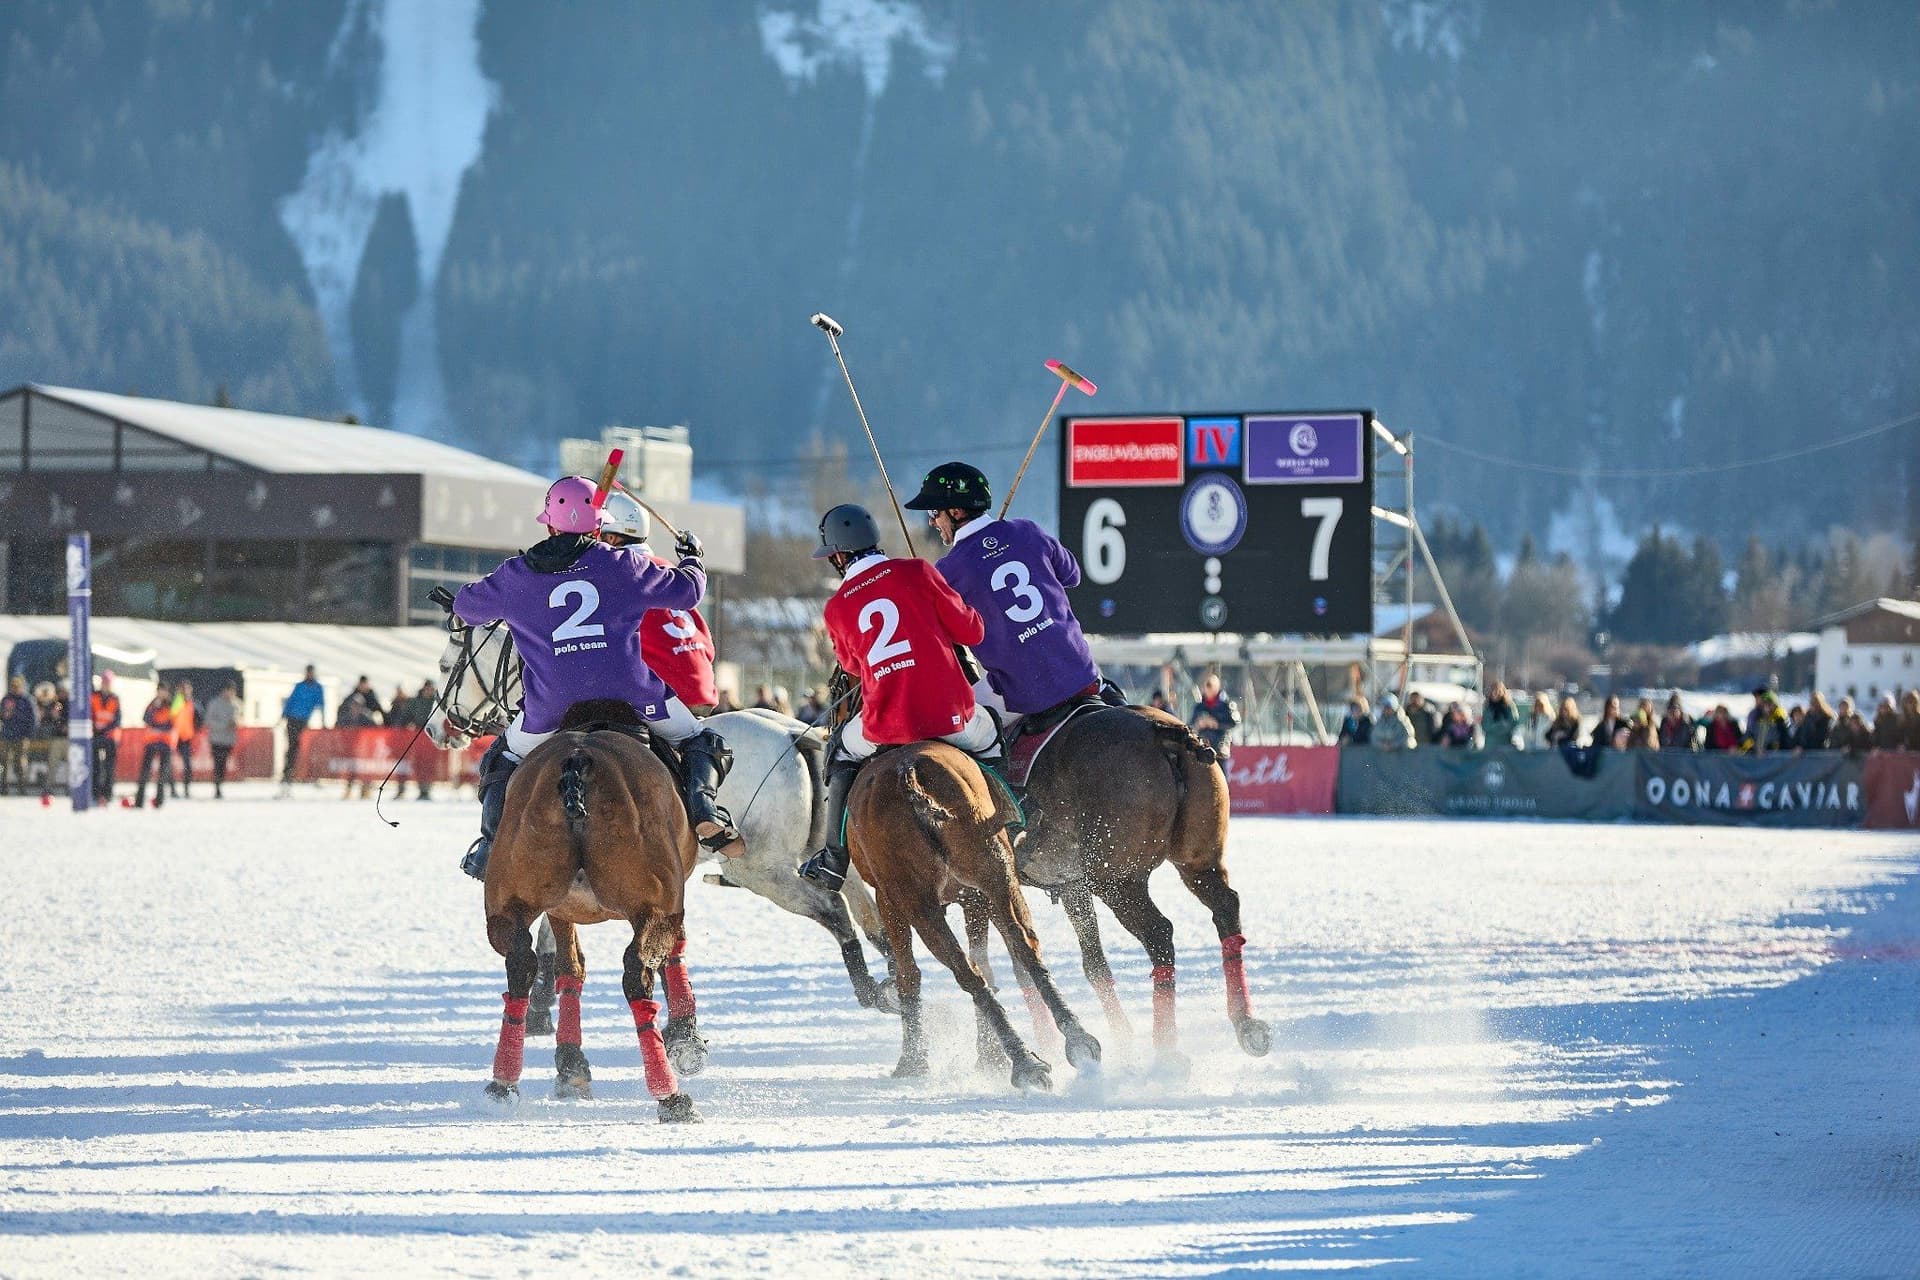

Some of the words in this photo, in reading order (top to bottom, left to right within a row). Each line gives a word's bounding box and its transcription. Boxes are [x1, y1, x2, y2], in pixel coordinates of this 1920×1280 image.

[1193, 426, 1235, 464] IV
[1083, 497, 1126, 585] 6
[1301, 496, 1343, 581] 7
[549, 579, 605, 642] 2
[991, 560, 1044, 623] 3
[554, 643, 578, 656] polo
[579, 641, 608, 651] team
[858, 597, 912, 667] 2
[1018, 625, 1038, 643] polo
[1036, 617, 1055, 633] team
[873, 664, 892, 681] polo
[891, 658, 915, 671] team
[1646, 776, 1731, 809] OONA
[1758, 781, 1859, 811] CAVIAR
